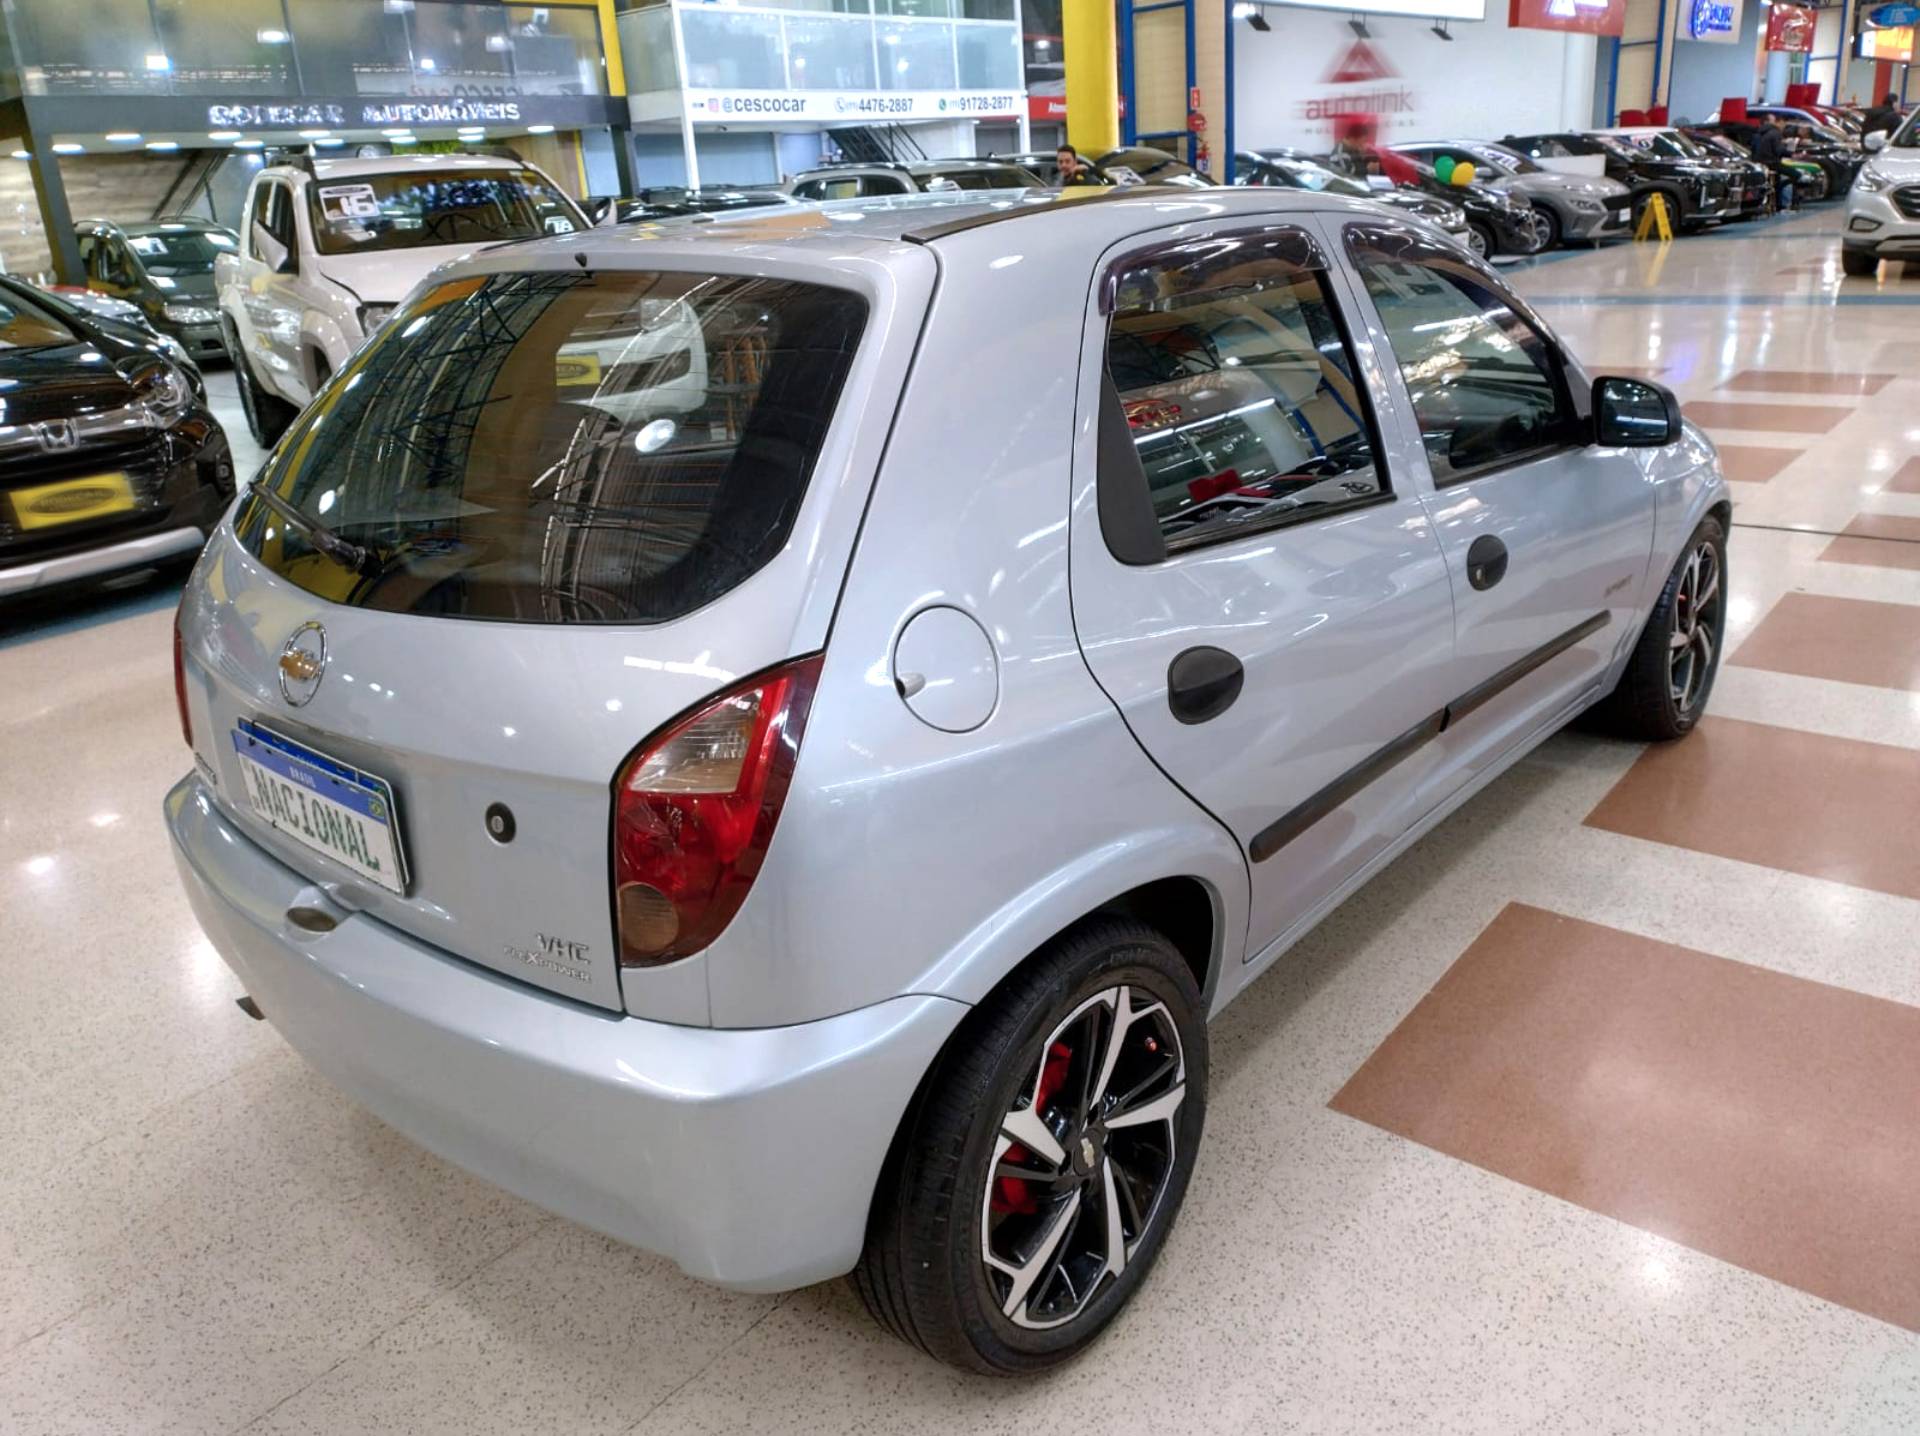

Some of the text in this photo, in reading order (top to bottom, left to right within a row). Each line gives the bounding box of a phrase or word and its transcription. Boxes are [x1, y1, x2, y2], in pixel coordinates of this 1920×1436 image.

[722, 97, 806, 112] @cescocar
[859, 98, 913, 112] 4476-2887
[251, 764, 380, 871] NACIONAL
